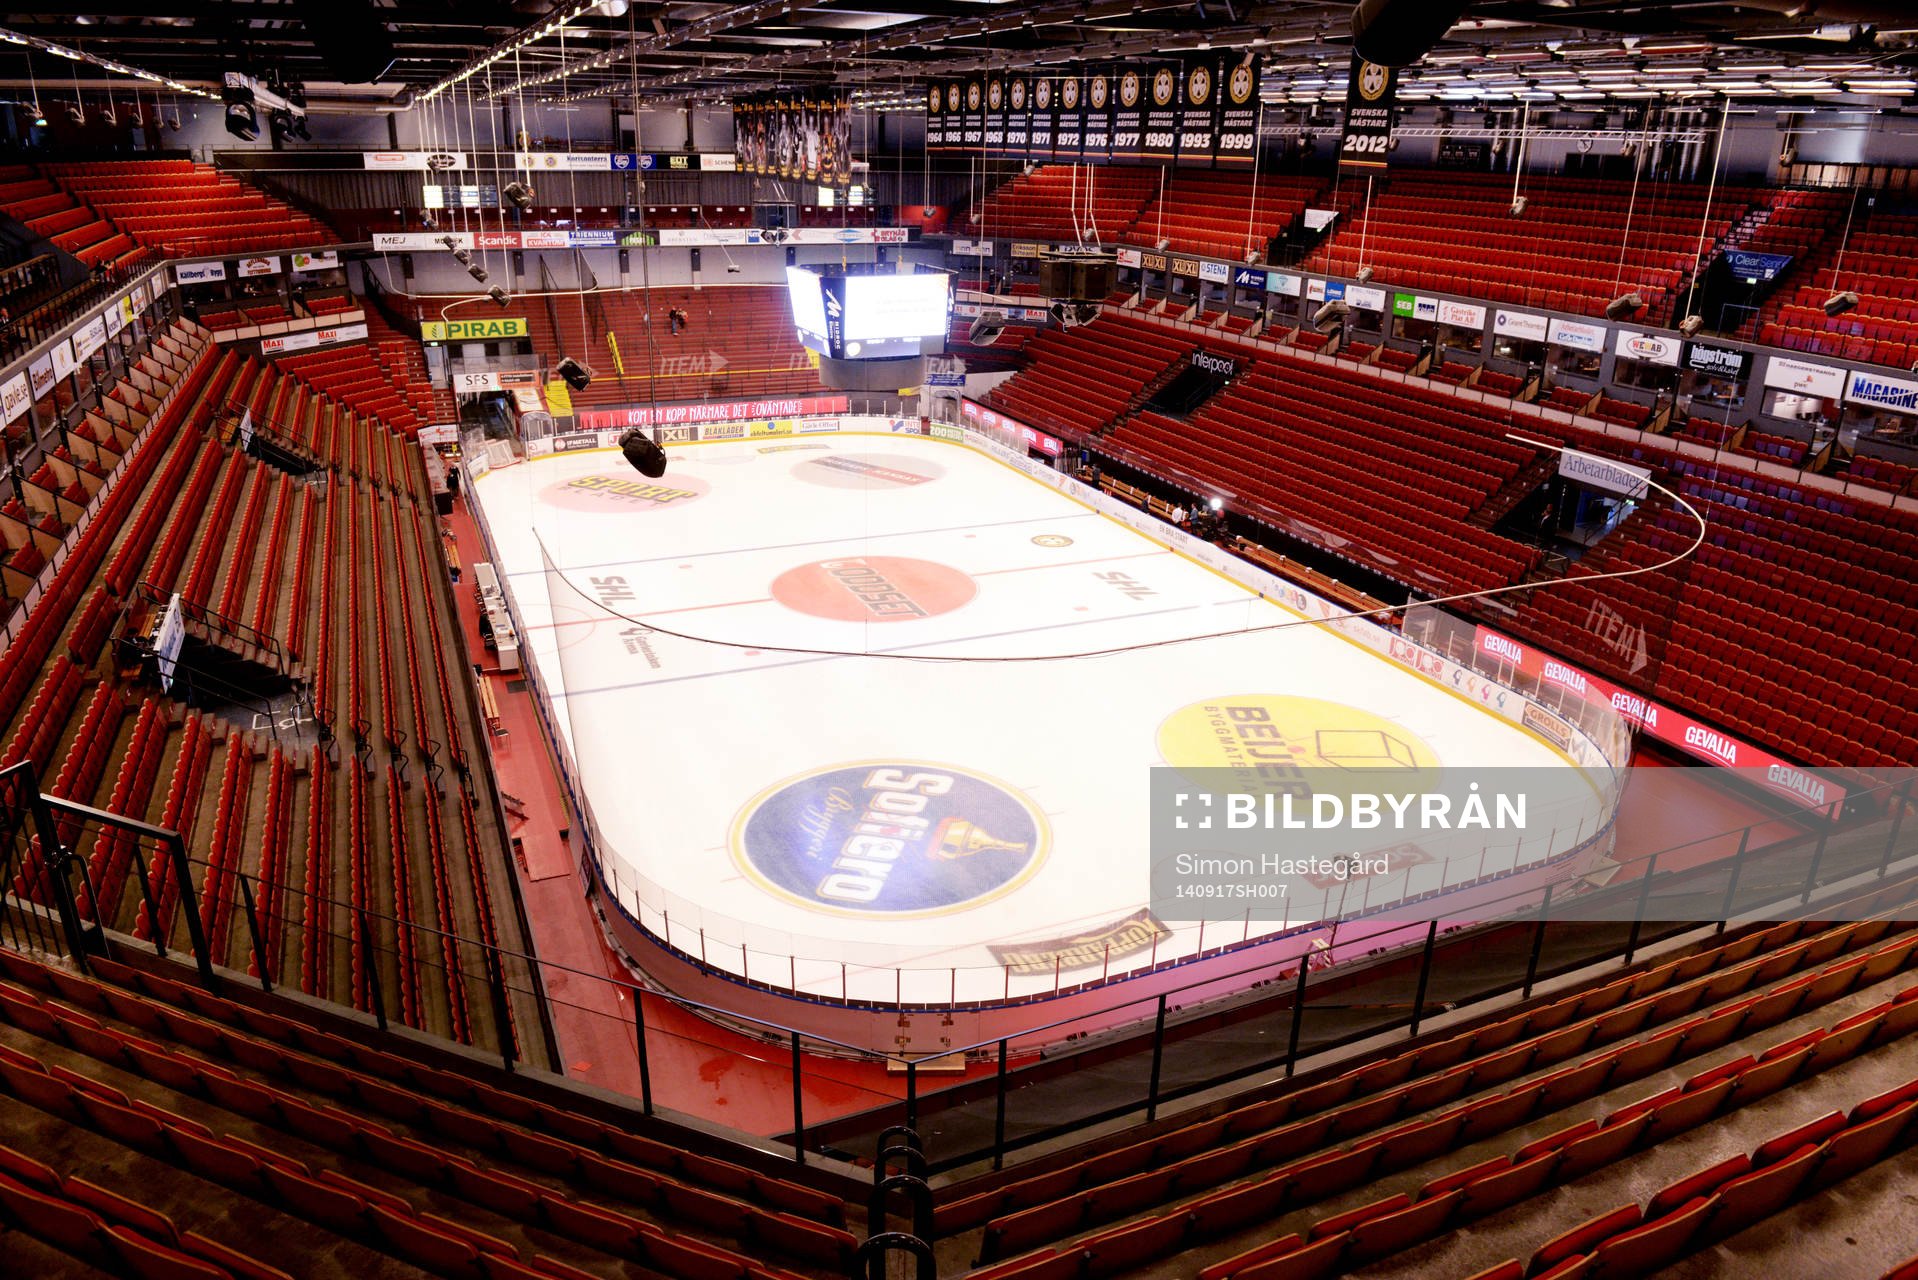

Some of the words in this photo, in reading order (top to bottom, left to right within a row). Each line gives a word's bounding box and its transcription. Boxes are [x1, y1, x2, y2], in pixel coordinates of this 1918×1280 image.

[1351, 108, 1388, 117] SVENSKA
[946, 132, 961, 142] 1966
[964, 131, 981, 142] 1967
[1007, 132, 1026, 144] 1970
[1032, 132, 1051, 144] 1971
[1058, 133, 1080, 146] 1972
[1085, 133, 1108, 146] 1976
[1114, 133, 1140, 146] 1977
[1145, 133, 1174, 147] 1980
[1180, 133, 1210, 148] 1993
[1220, 134, 1253, 150] 1999
[1343, 135, 1387, 152] 2012
[381, 236, 406, 244] MEJ
[478, 236, 517, 246] Scandic
[1206, 264, 1226, 276] STENA
[1396, 300, 1412, 310] SEB
[318, 330, 337, 340] MAXI
[448, 321, 518, 338] PIRAB
[263, 340, 284, 349] MAXI
[1690, 344, 1742, 368] högström
[659, 356, 706, 376] ITEM
[465, 374, 488, 386] SFS
[628, 408, 646, 424] KOM
[666, 406, 687, 421] KOPP
[732, 402, 749, 418] DET
[568, 475, 698, 503] SPORT
[590, 576, 636, 606] SHL
[1585, 600, 1635, 662] ITEM
[1484, 634, 1522, 664] GEVALIA
[1544, 662, 1586, 694] GEVALIA
[1611, 692, 1658, 728] GEVALIA
[1530, 708, 1568, 738] GROLLS
[1684, 726, 1737, 764] GEVALIA
[1225, 706, 1313, 800] BEIJER
[1767, 764, 1825, 805] GEVALIA
